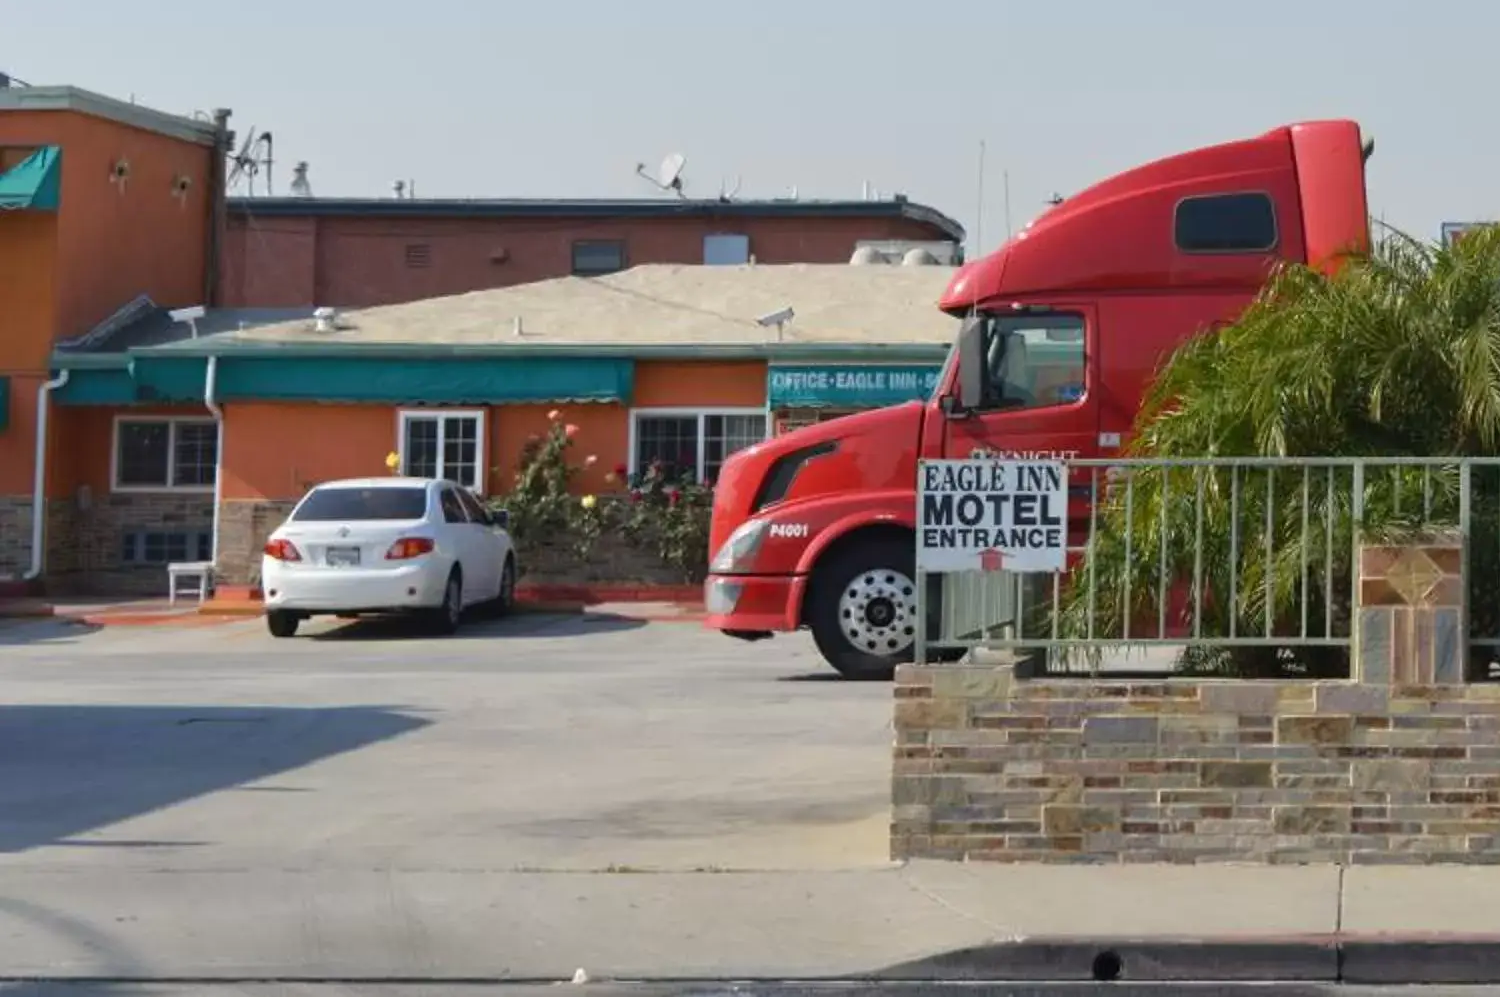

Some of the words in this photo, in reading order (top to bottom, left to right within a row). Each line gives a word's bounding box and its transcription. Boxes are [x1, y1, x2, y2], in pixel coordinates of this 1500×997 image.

[772, 372, 829, 390] OFFICE
[835, 372, 885, 389] EAGLE
[889, 372, 916, 389] INN
[923, 464, 1005, 492] EAGLE
[1016, 464, 1060, 492] INN
[923, 493, 1061, 526] MOTEL
[769, 523, 808, 538] P4001
[923, 528, 1061, 548] ENTRANCE
